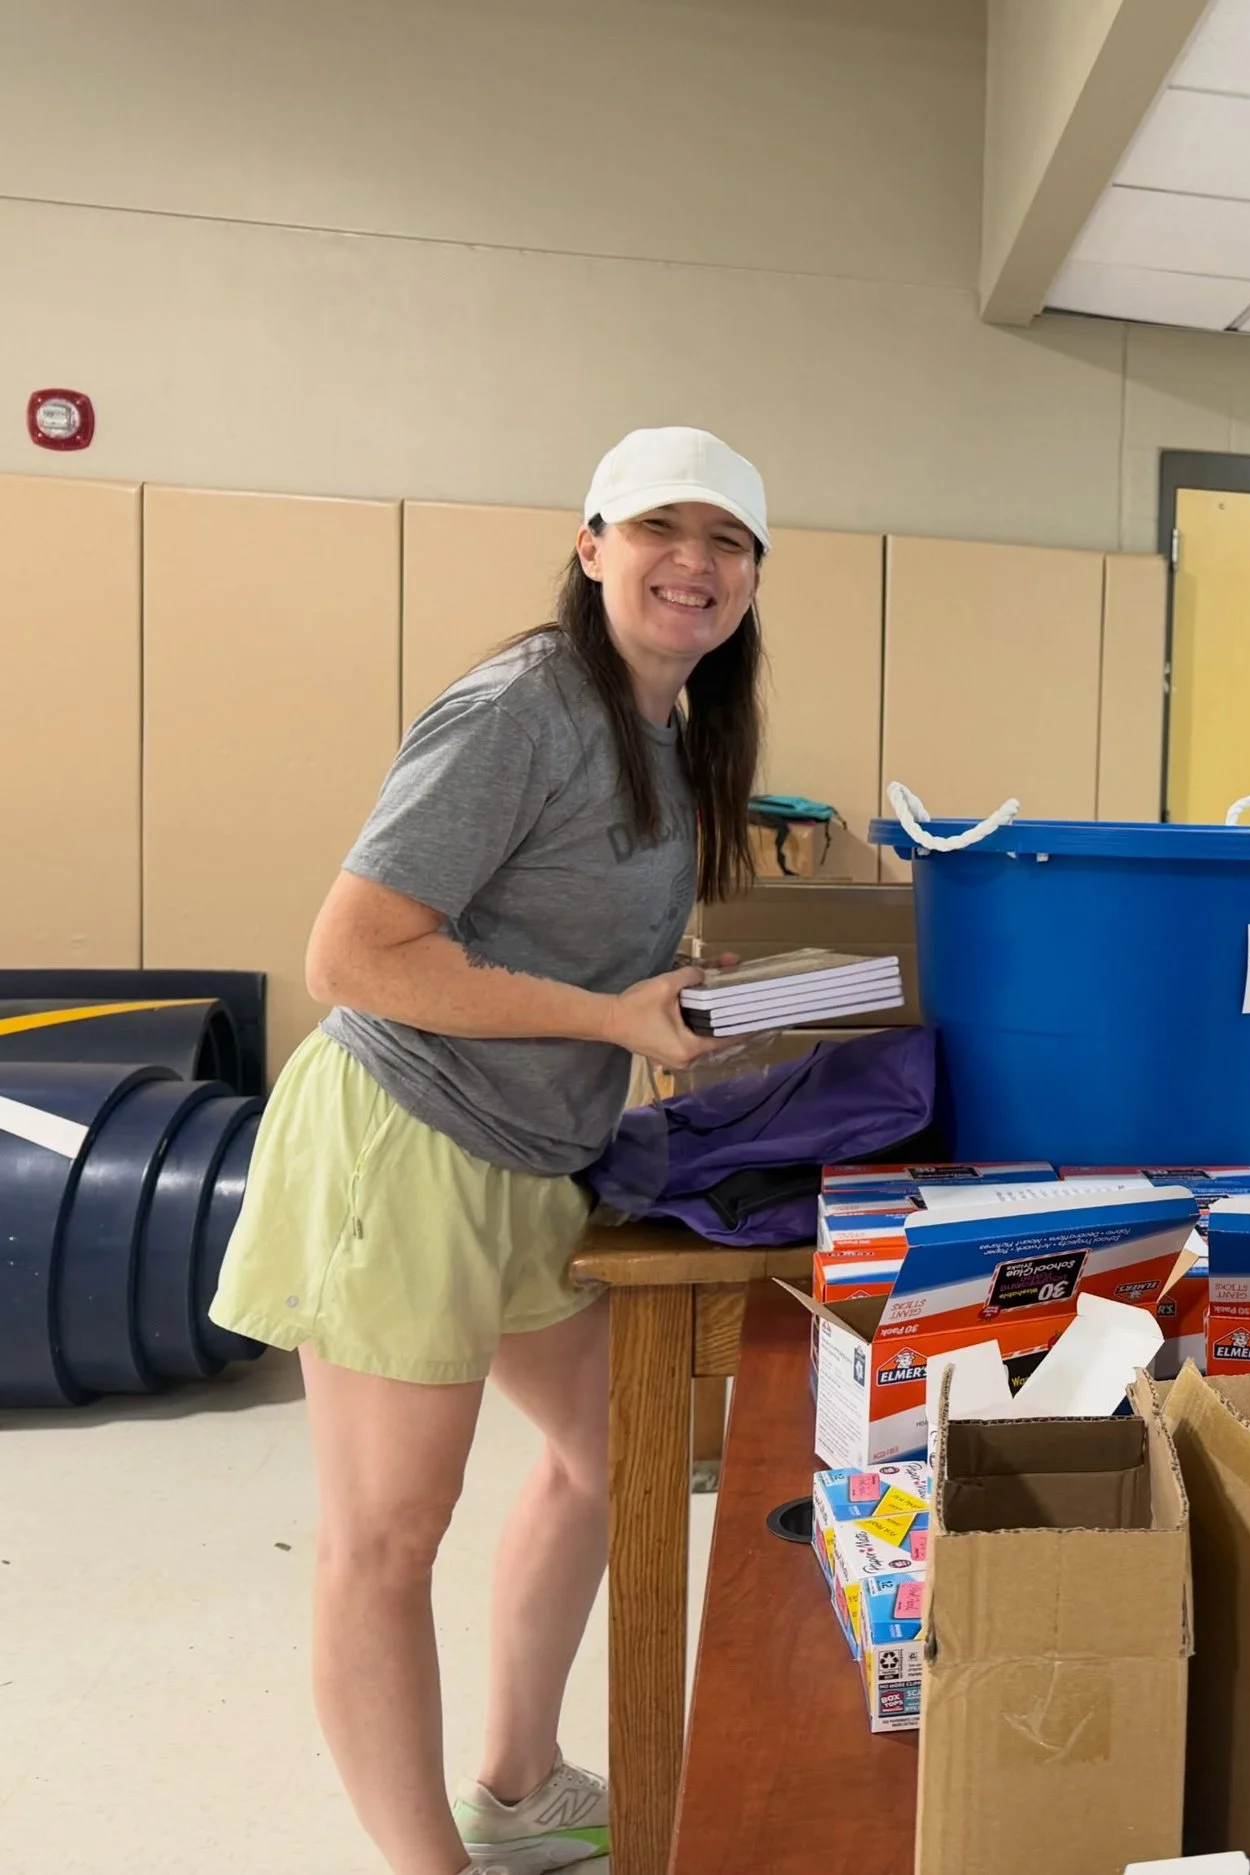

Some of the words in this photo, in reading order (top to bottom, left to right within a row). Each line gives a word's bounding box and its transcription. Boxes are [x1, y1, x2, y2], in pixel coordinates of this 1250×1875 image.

[1038, 1280, 1069, 1301] 30
[880, 1327, 904, 1337] Pack
[904, 1324, 920, 1334] 30
[880, 1693, 901, 1704] BOX
[883, 1699, 904, 1708] TOPS
